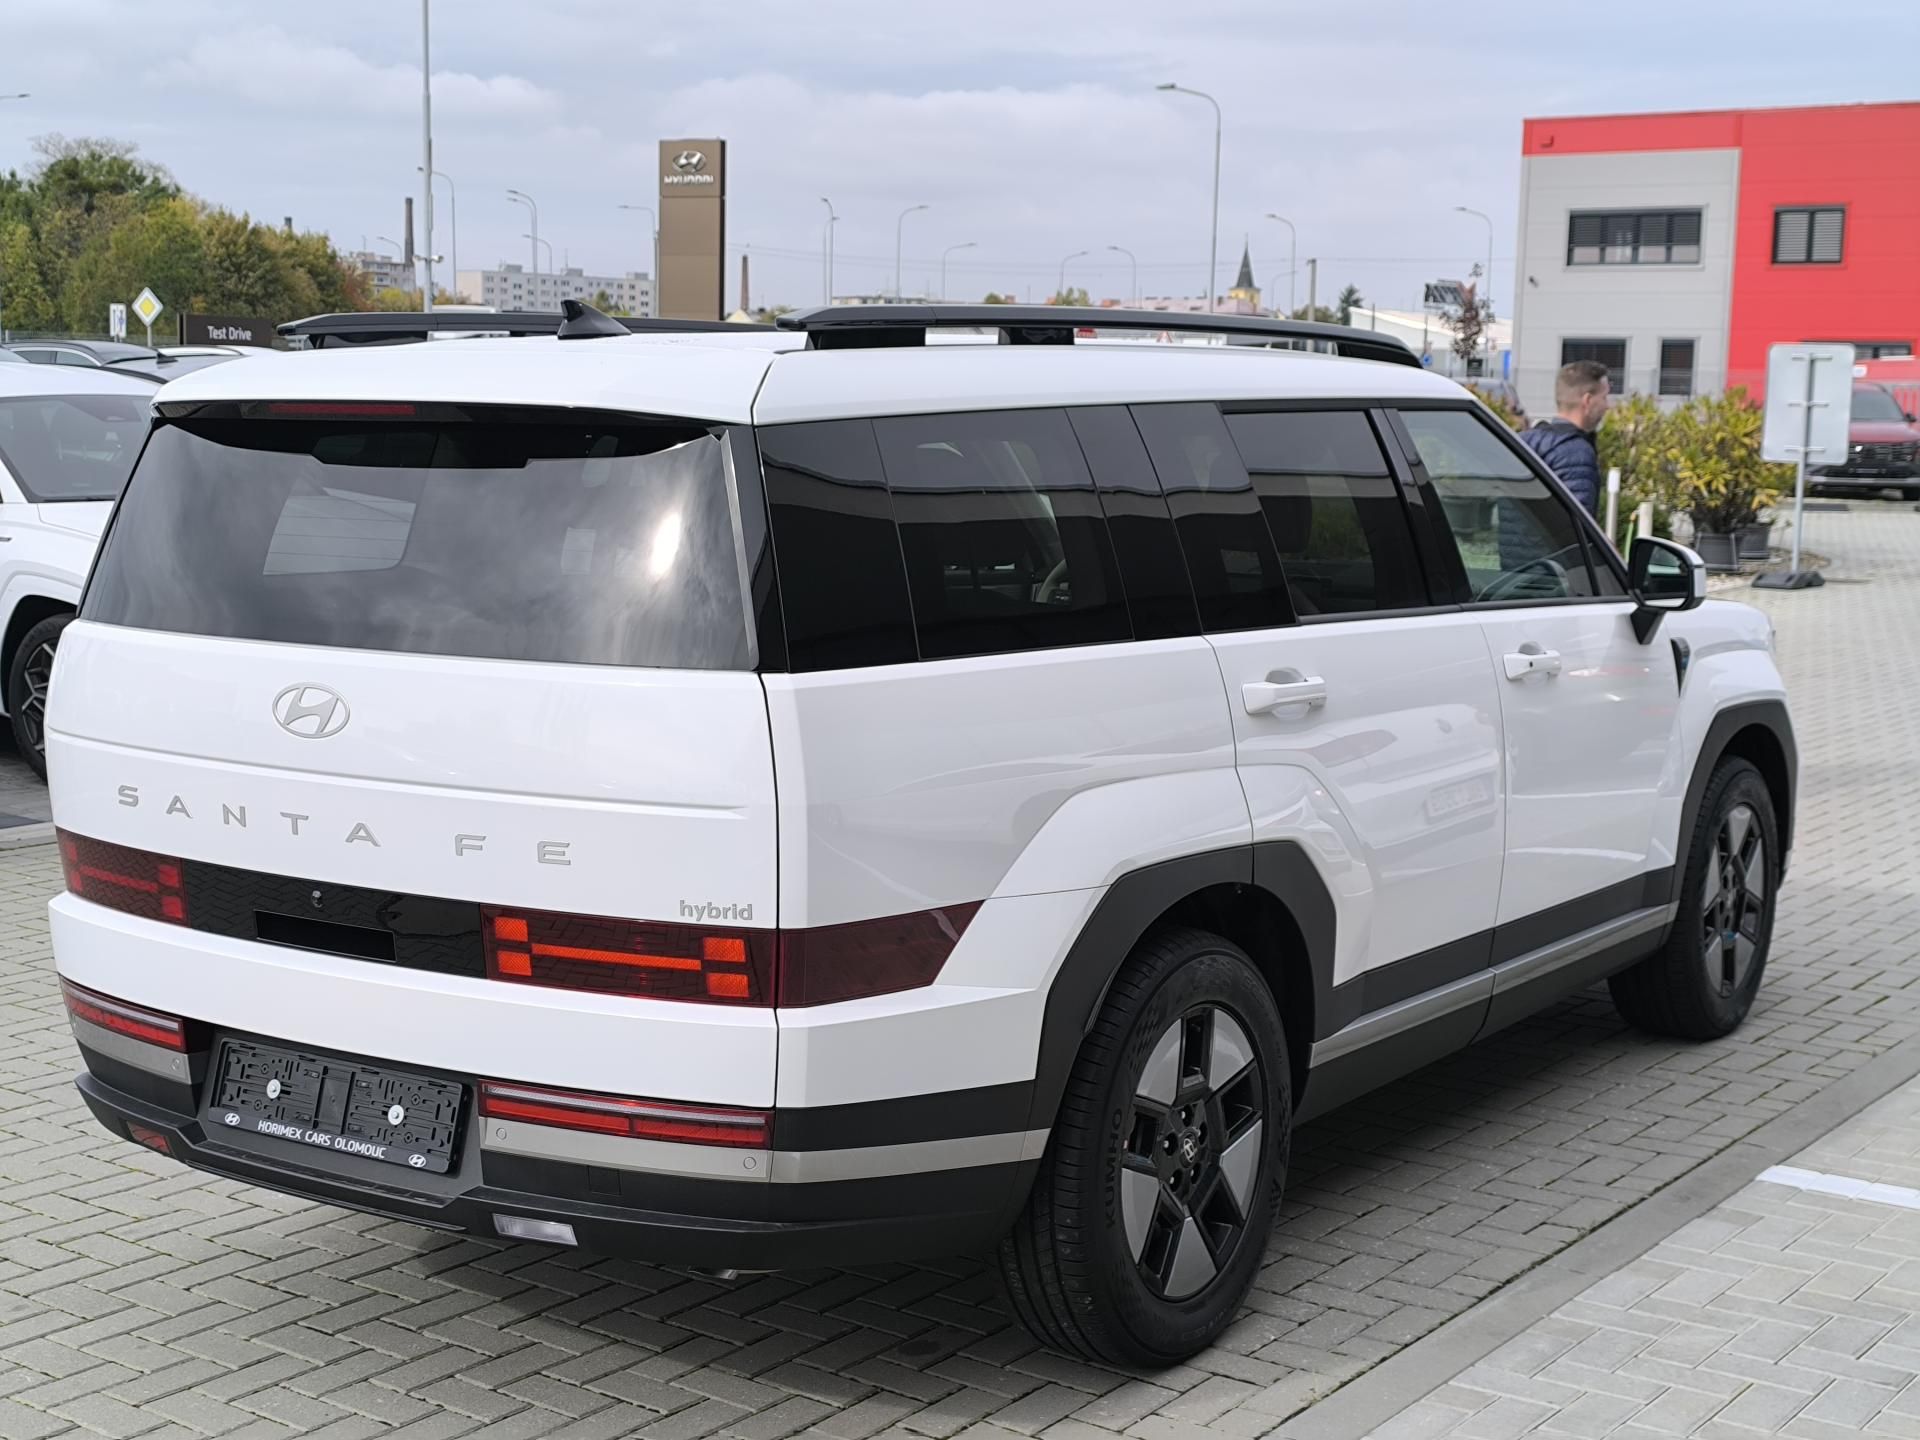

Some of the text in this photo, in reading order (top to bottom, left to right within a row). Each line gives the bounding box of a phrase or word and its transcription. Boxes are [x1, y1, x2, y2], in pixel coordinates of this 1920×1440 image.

[207, 325, 252, 341] Test Drive
[118, 785, 572, 865] SANTA FE
[680, 900, 753, 922] hybrid
[257, 1120, 387, 1159] HORIMEX CARS OLOMOUC
[1105, 1108, 1122, 1230] KUMHO
